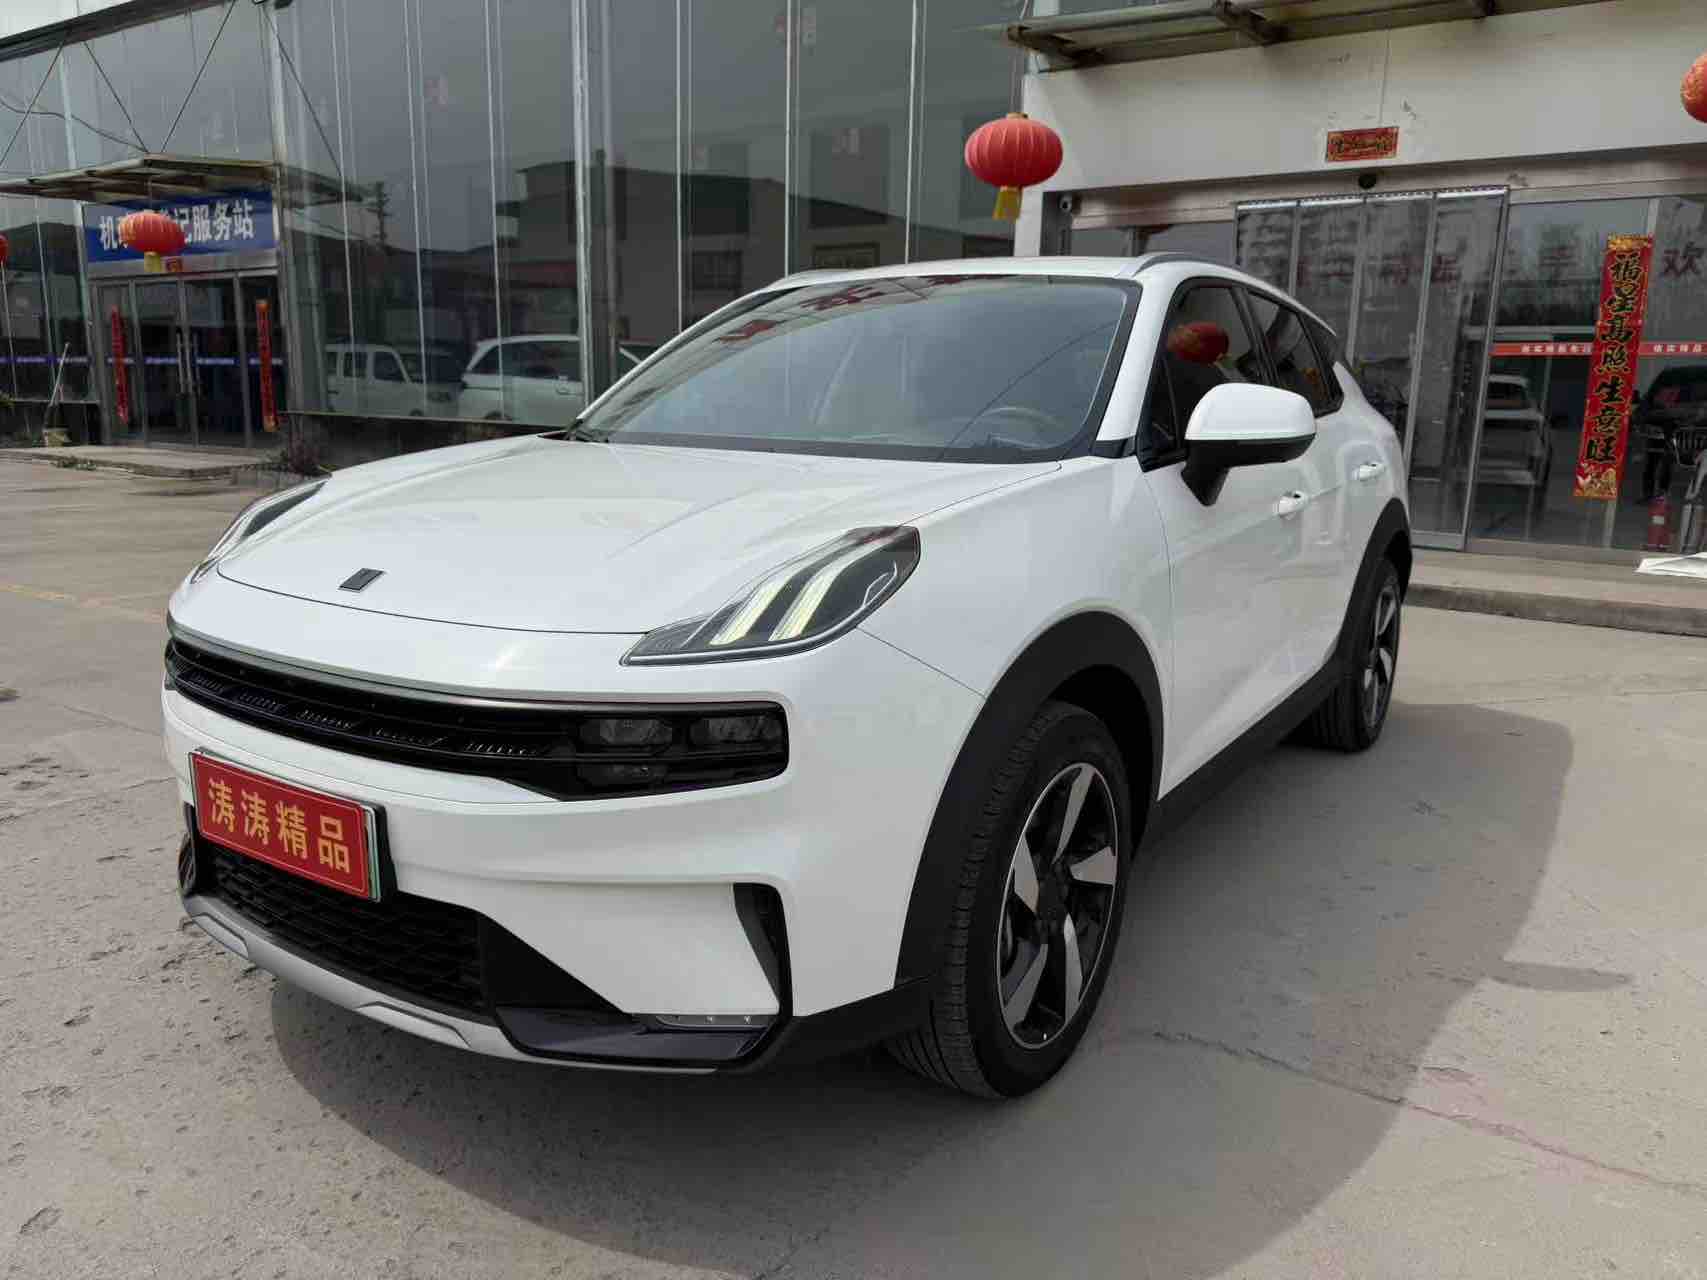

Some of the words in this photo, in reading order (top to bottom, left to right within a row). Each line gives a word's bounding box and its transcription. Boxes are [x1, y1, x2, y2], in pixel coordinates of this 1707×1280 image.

[99, 198, 254, 251] 机记服务站
[1584, 254, 1642, 464] 福星高照生意旺
[207, 777, 351, 873] 涛涛精品
